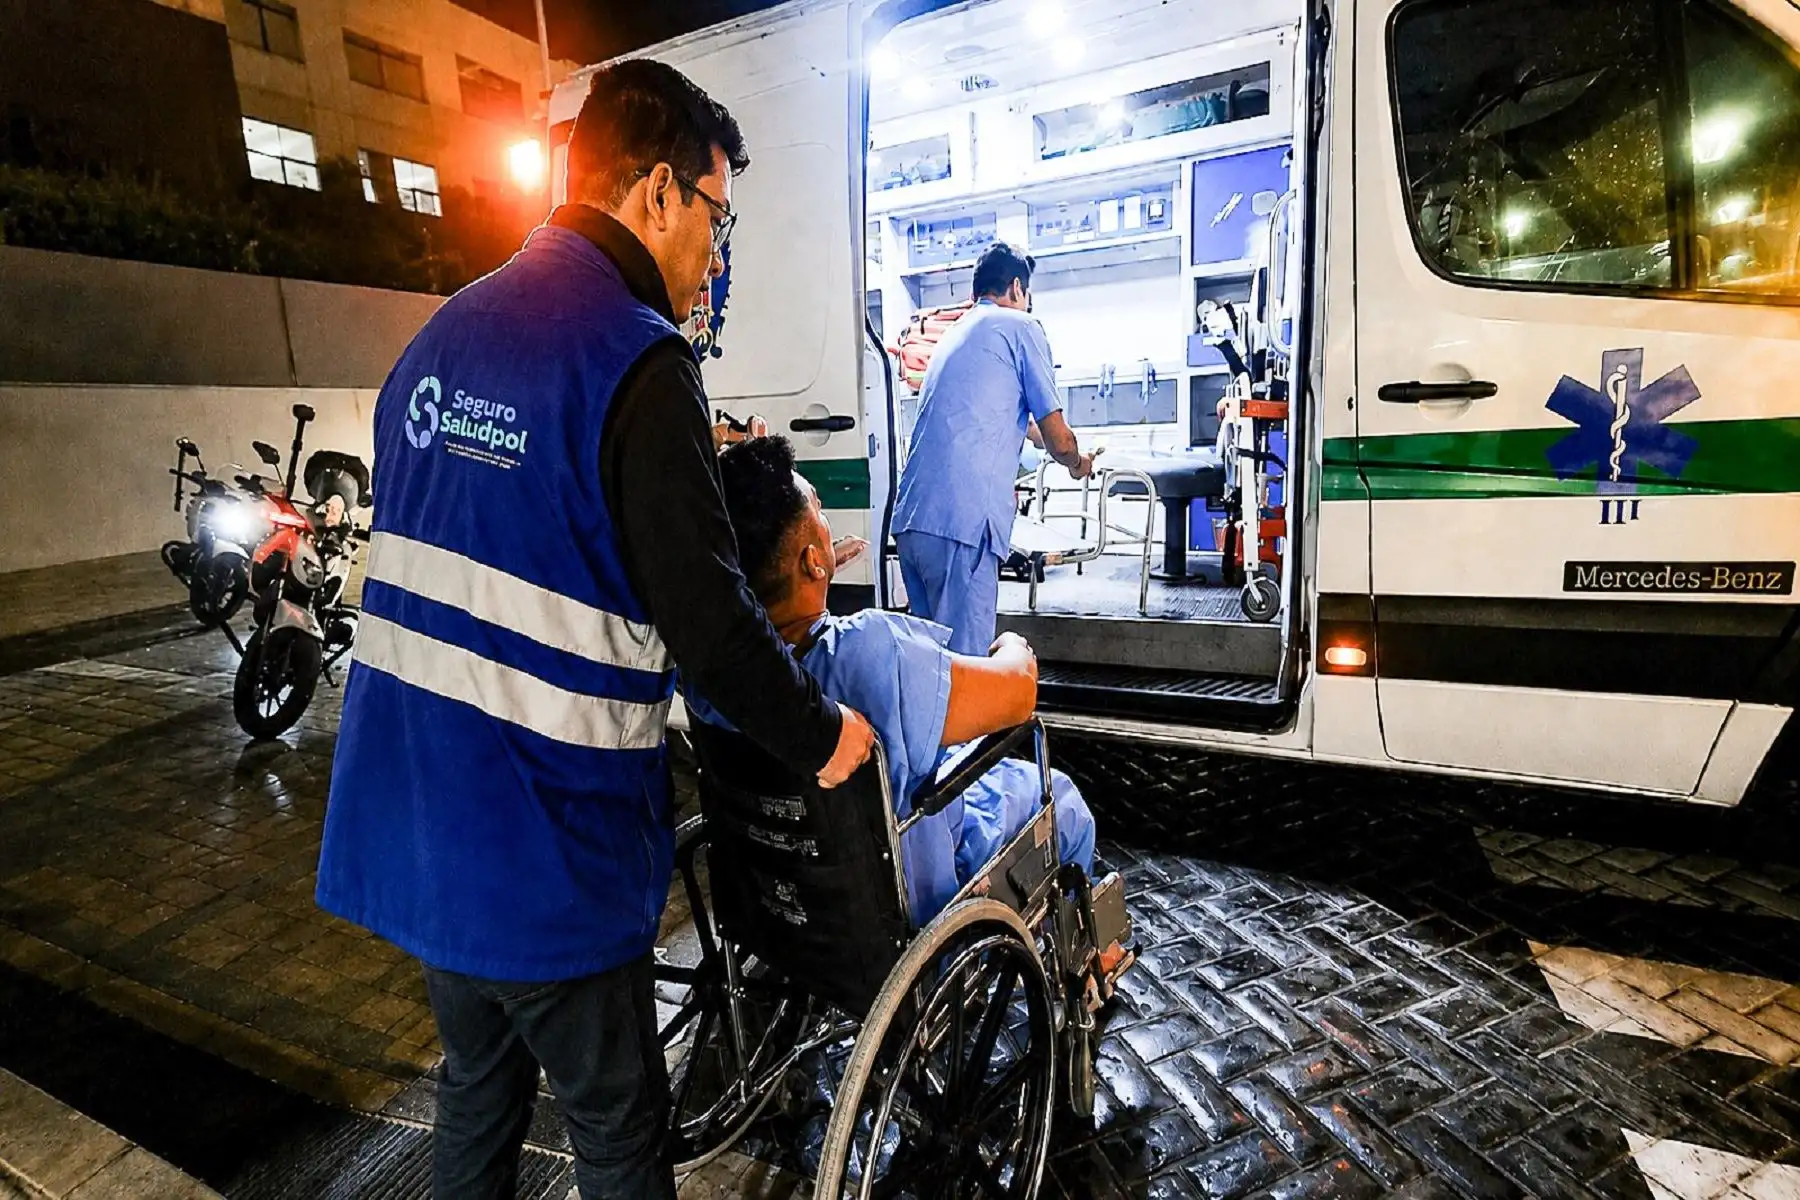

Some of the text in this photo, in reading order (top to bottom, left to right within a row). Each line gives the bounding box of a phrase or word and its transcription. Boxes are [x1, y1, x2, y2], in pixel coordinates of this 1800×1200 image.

[452, 389, 516, 422] Seguro
[440, 410, 528, 454] Saludpol
[1574, 565, 1782, 590] Mercedes-Benz
